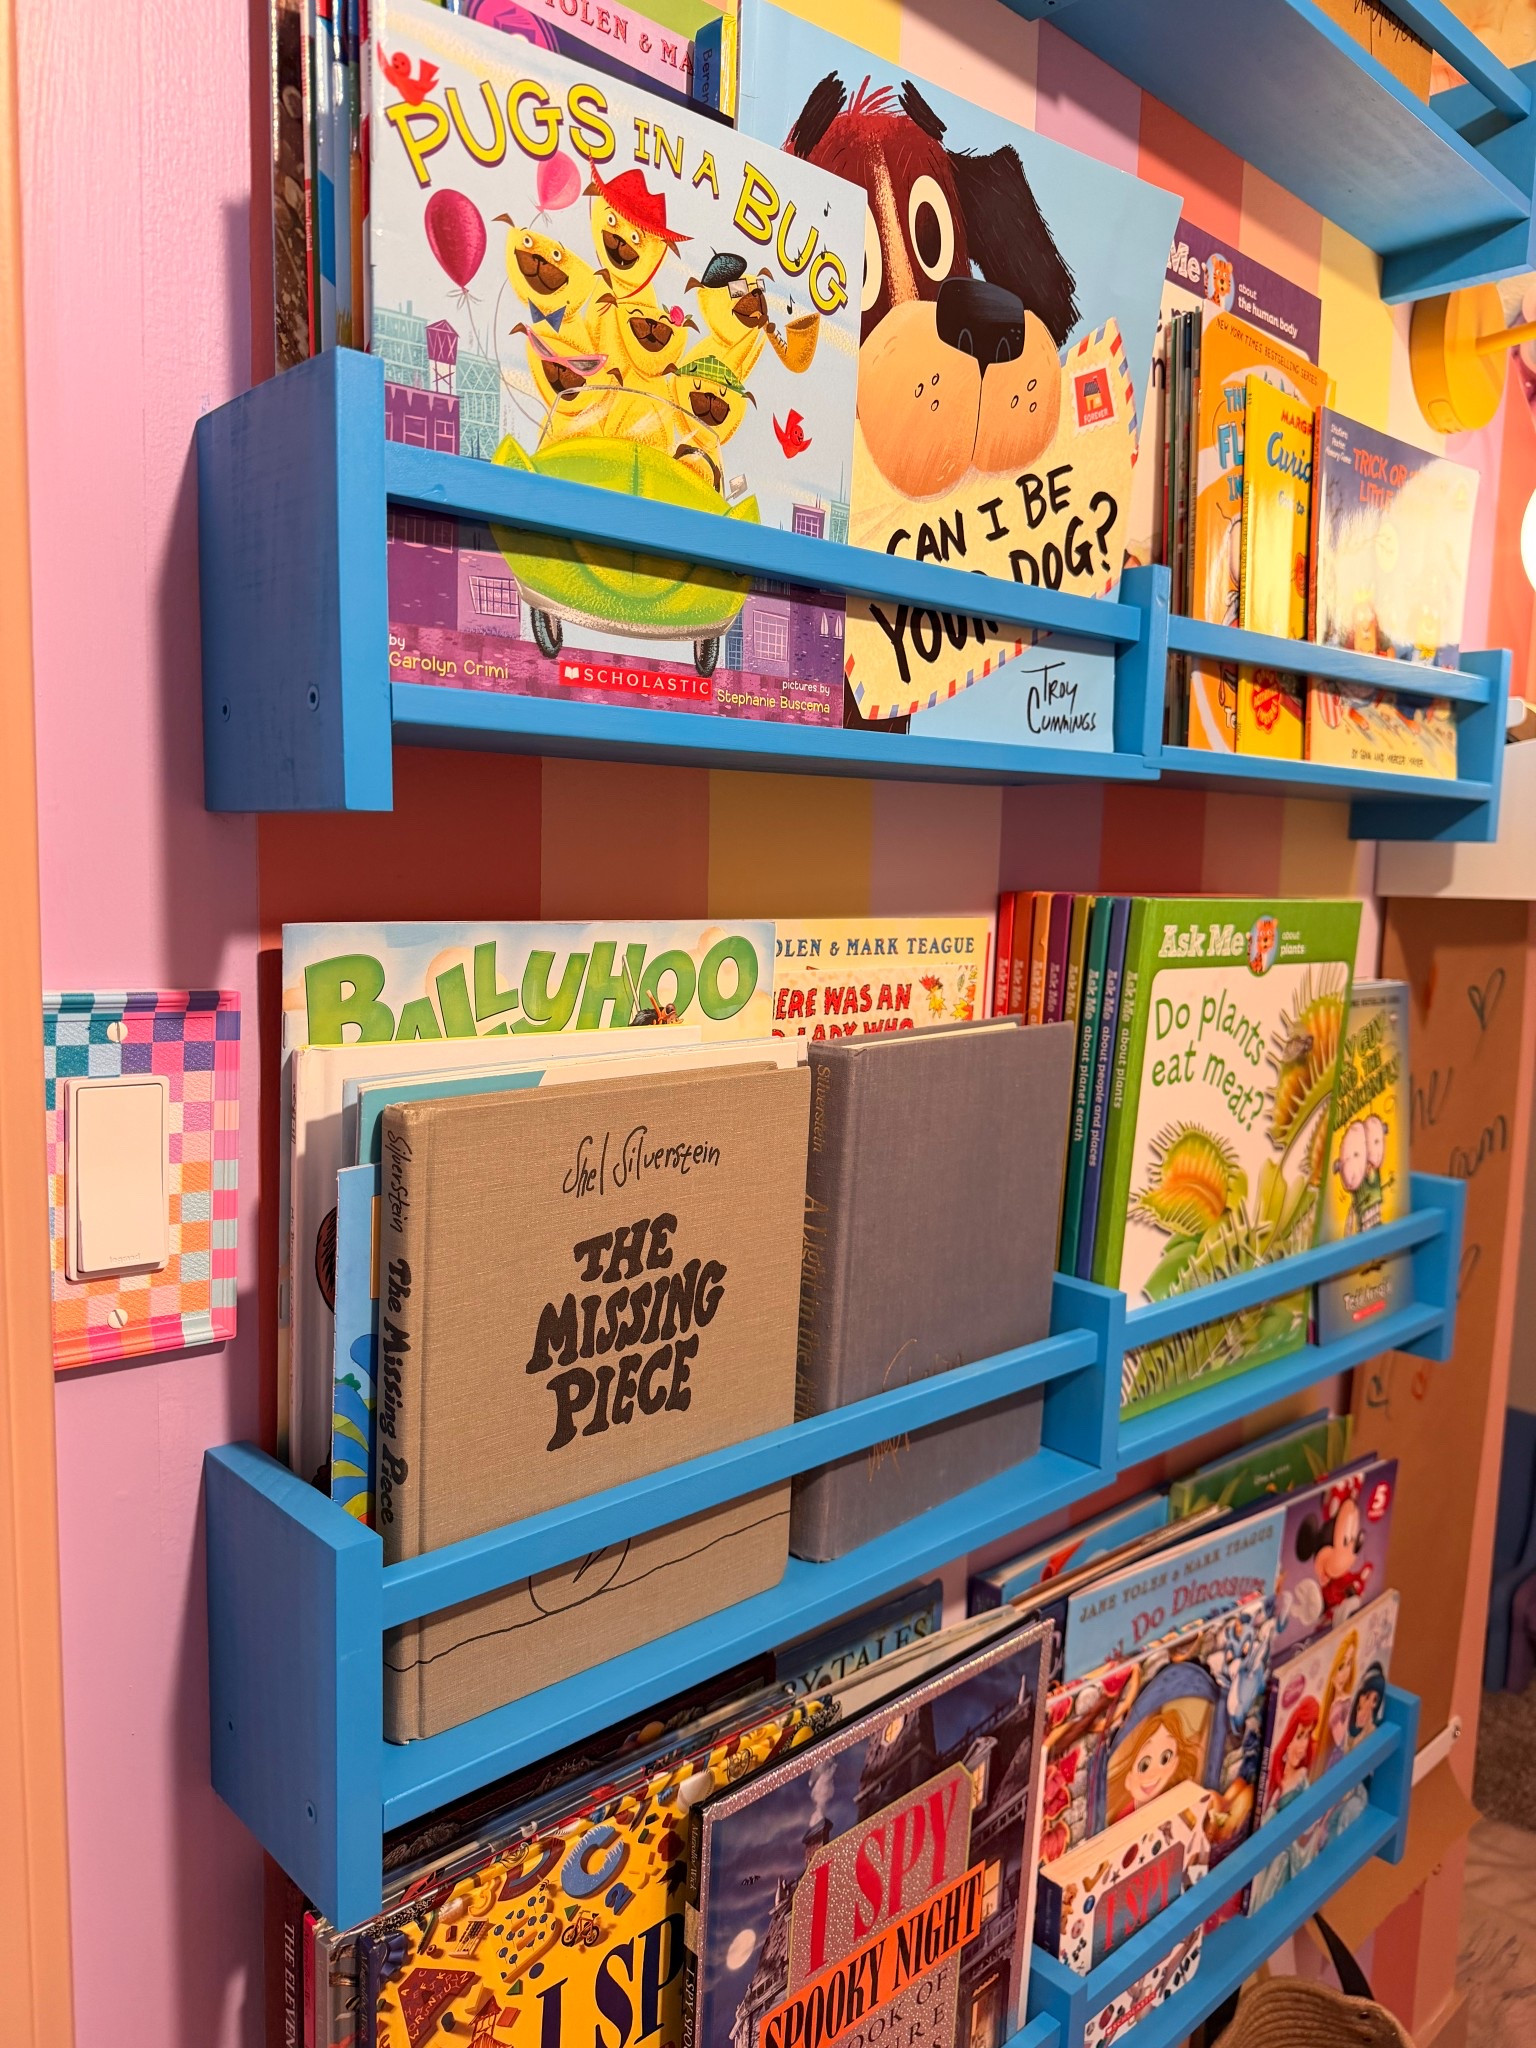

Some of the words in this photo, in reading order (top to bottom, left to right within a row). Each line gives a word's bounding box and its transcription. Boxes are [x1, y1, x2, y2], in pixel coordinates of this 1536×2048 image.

[639, 32, 652, 53] &
[386, 80, 617, 188] PUGS
[633, 118, 686, 180] IN
[692, 153, 722, 200] A
[732, 161, 850, 316] BUG
[1167, 241, 1201, 283] Me
[1238, 283, 1257, 300] about
[1238, 296, 1251, 312] the
[1252, 304, 1279, 329] human
[1279, 317, 1298, 339] body
[1216, 318, 1227, 331] NEW
[1229, 328, 1243, 342] YORK
[1244, 335, 1262, 353] TIMES
[1264, 346, 1299, 374] BESTSELLING
[1217, 421, 1245, 469] FL
[1353, 447, 1388, 483] TRICK
[1389, 464, 1407, 488] OR
[886, 510, 966, 562] CAN
[977, 497, 1010, 541] I
[1015, 464, 1074, 529] BE
[1008, 492, 1118, 592] DOG?
[389, 633, 406, 650] by
[464, 659, 509, 679] Crimi
[583, 667, 710, 696] SCHOLASTIC
[717, 689, 776, 709] Stephanie
[780, 696, 831, 714] Buscema
[782, 679, 817, 694] pictures
[819, 683, 831, 696] by
[829, 940, 841, 956] &
[846, 938, 899, 956] MARK
[906, 937, 974, 955] TEAGUE
[1158, 924, 1205, 959] Ask
[1206, 924, 1245, 957] Me
[1280, 943, 1305, 957] plants
[1281, 931, 1299, 941] about
[304, 935, 758, 1044] BALLYHOO
[772, 988, 818, 1020] ERE
[823, 983, 873, 1016] WAS
[876, 983, 912, 1012] AN
[1088, 968, 1099, 996] Ask
[1107, 968, 1118, 996] Ask
[1126, 970, 1138, 998] Ask
[1084, 996, 1097, 1020] Me
[1102, 997, 1115, 1021] Me
[1122, 999, 1134, 1023] Me
[1155, 998, 1190, 1040] Do
[1198, 988, 1266, 1066] plants
[1083, 1026, 1092, 1062] about
[1101, 1026, 1110, 1062] about
[1119, 1028, 1129, 1066] about
[1077, 1064, 1088, 1105] planet
[1094, 1063, 1106, 1104] people
[1113, 1068, 1126, 1109] plants
[1152, 1040, 1197, 1087] eat
[1202, 1053, 1265, 1131] meat?
[812, 1064, 831, 1153] Silverstein
[1074, 1106, 1084, 1142] earth
[1091, 1105, 1101, 1128] and
[563, 1132, 610, 1198] Shel
[613, 1125, 721, 1188] Silverstein
[1088, 1129, 1100, 1168] places
[385, 1130, 412, 1233] Silverstein
[805, 1192, 829, 1215] A
[573, 1212, 678, 1283] THE
[801, 1221, 828, 1290] Light
[387, 1258, 412, 1313] The
[525, 1258, 727, 1374] MISSING
[798, 1327, 820, 1367] the
[379, 1316, 412, 1439] Missing
[546, 1333, 699, 1452] PIECE
[380, 1443, 409, 1525] Piece
[1373, 1484, 1388, 1510] 5
[1079, 1594, 1117, 1623] JANE
[1123, 1573, 1168, 1603] YOLEN
[1184, 1550, 1220, 1576] MARK
[1226, 1525, 1274, 1557] TEAGUE
[1131, 1611, 1165, 1645] Do
[688, 1822, 699, 1890] Marzollo/Wick
[804, 1860, 834, 1978] I
[853, 1779, 961, 1942] SPY
[1104, 1893, 1117, 1952] I
[1124, 1850, 1176, 1936] SPY
[284, 1922, 295, 1967] THE
[764, 1938, 888, 2048] SPOOKY
[891, 1870, 983, 1993] NIGHT
[916, 1967, 948, 2006] OF
